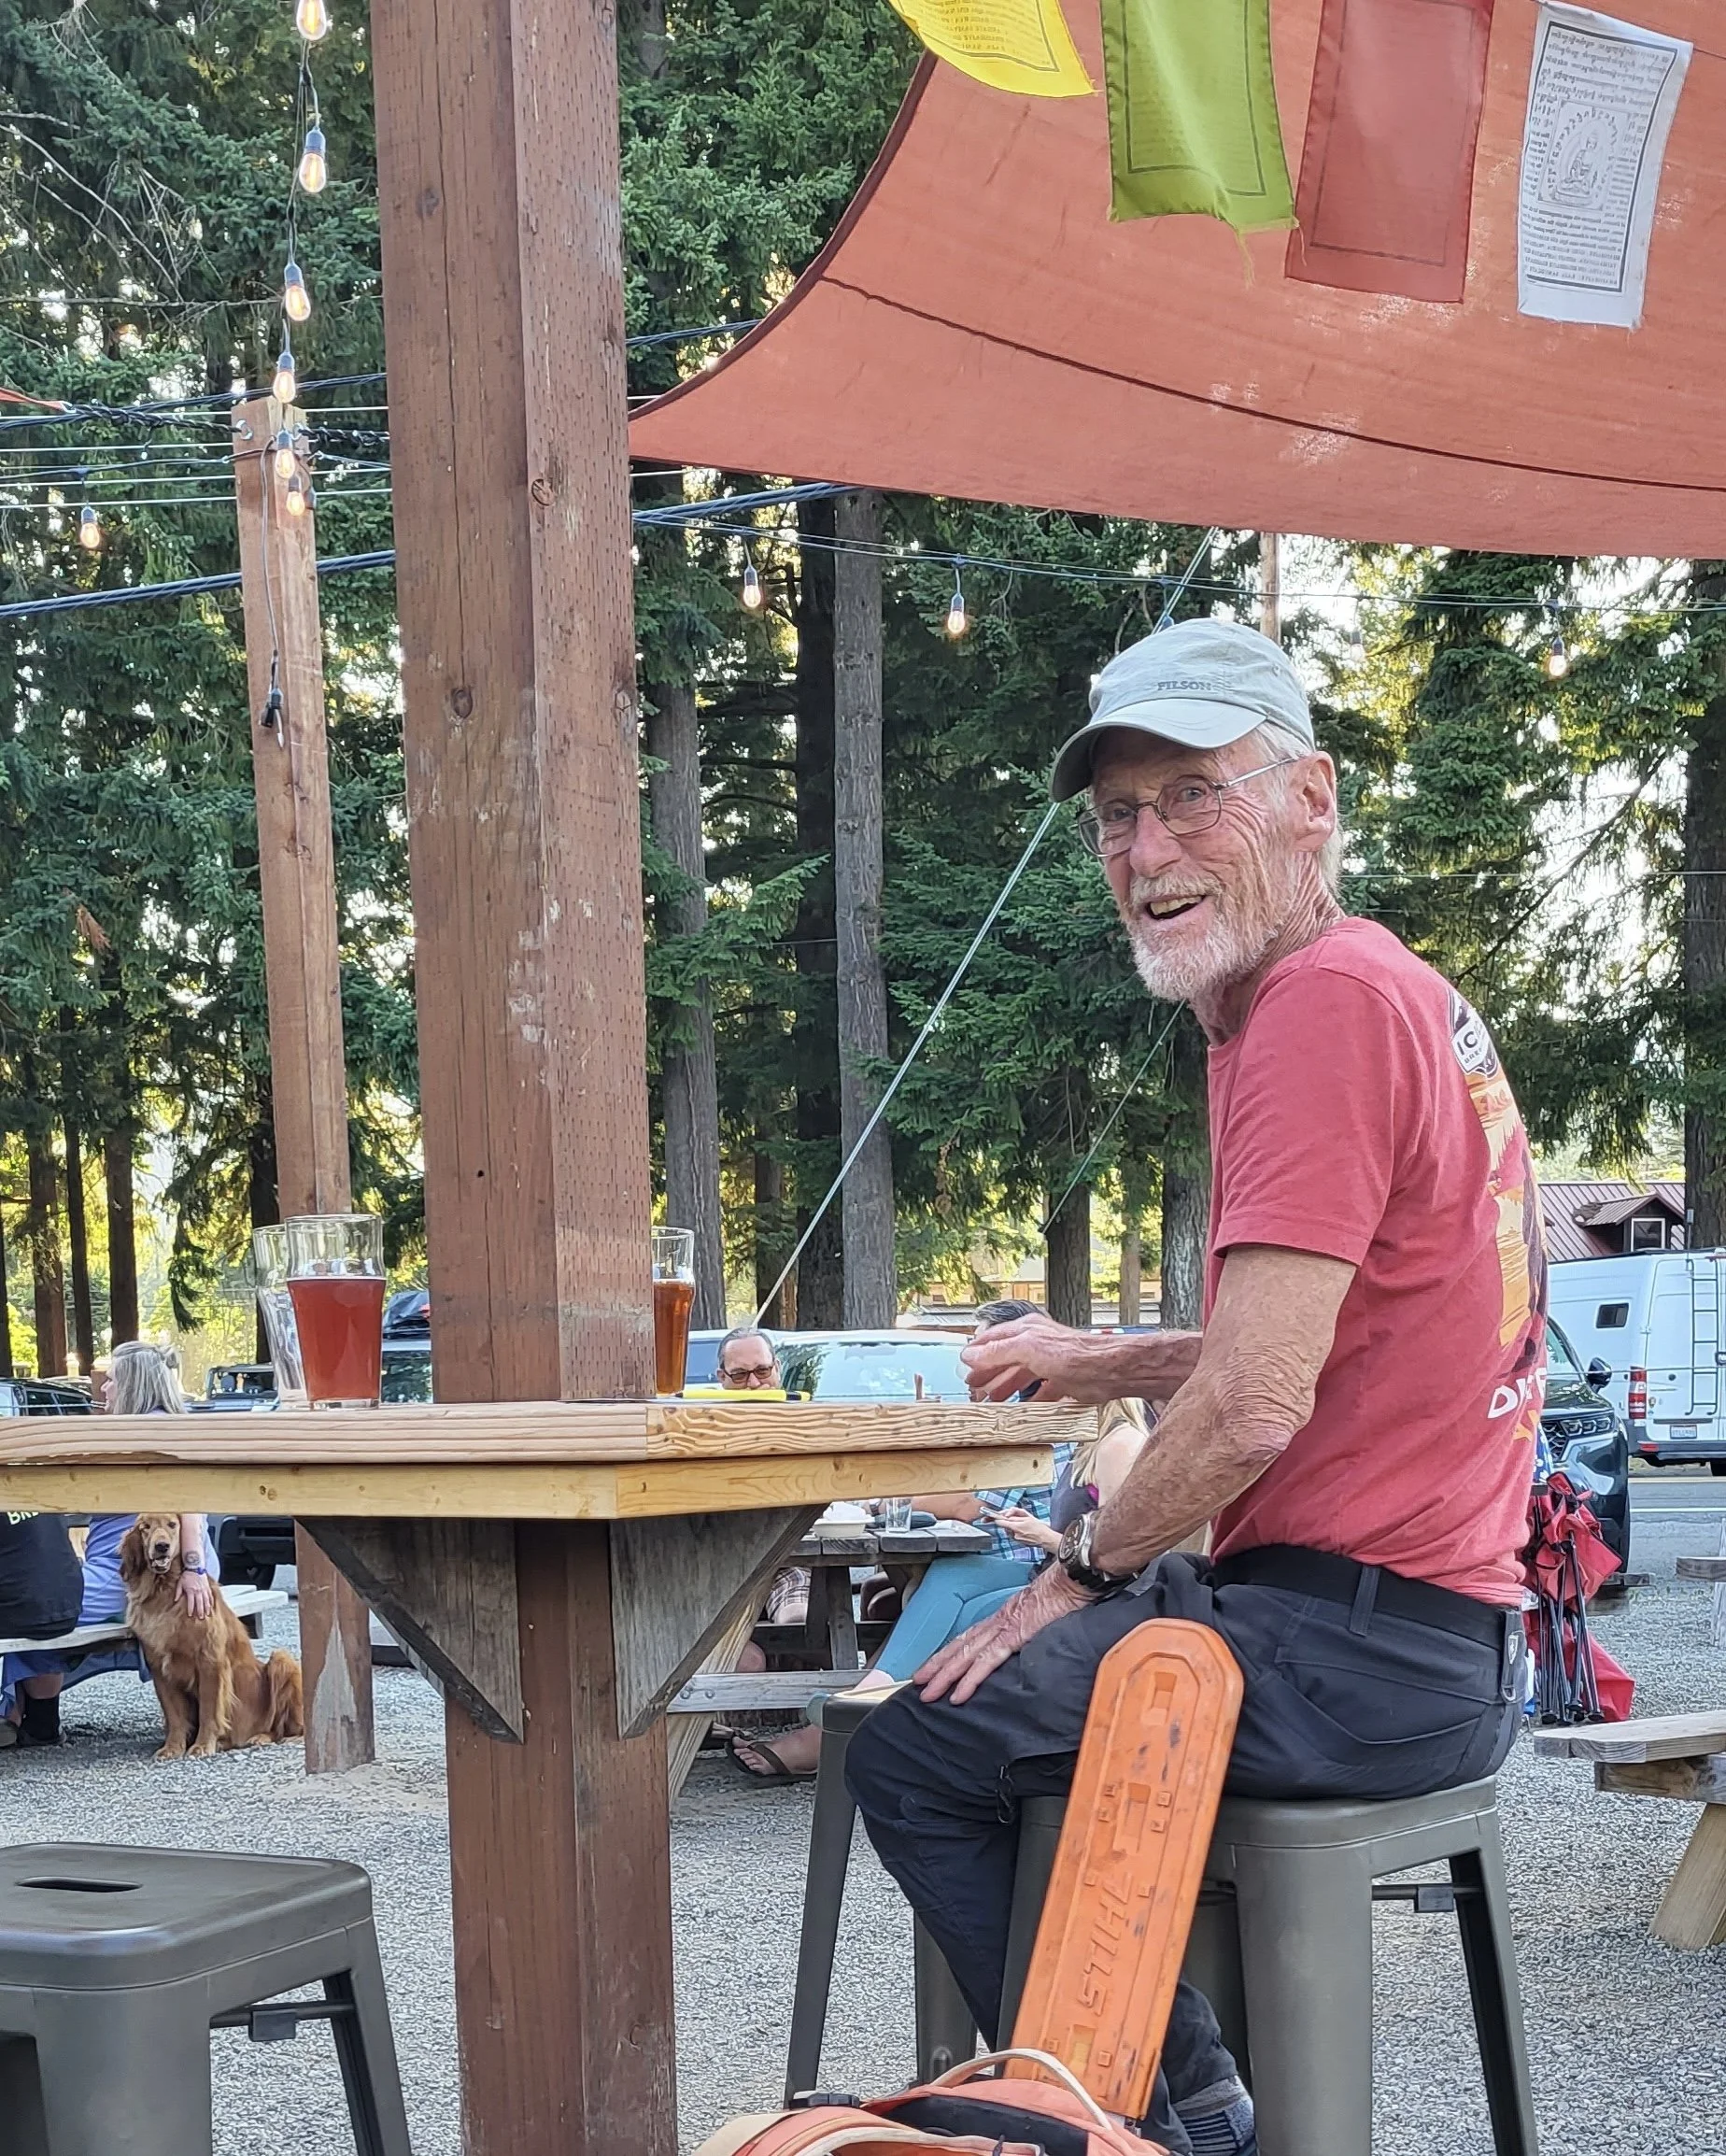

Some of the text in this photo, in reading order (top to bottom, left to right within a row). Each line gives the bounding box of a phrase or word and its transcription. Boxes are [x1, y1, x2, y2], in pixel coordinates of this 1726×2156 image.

[1157, 680, 1211, 691] FILSON
[7, 1511, 39, 1525] BR
[1075, 1871, 1134, 2018] STIHL
